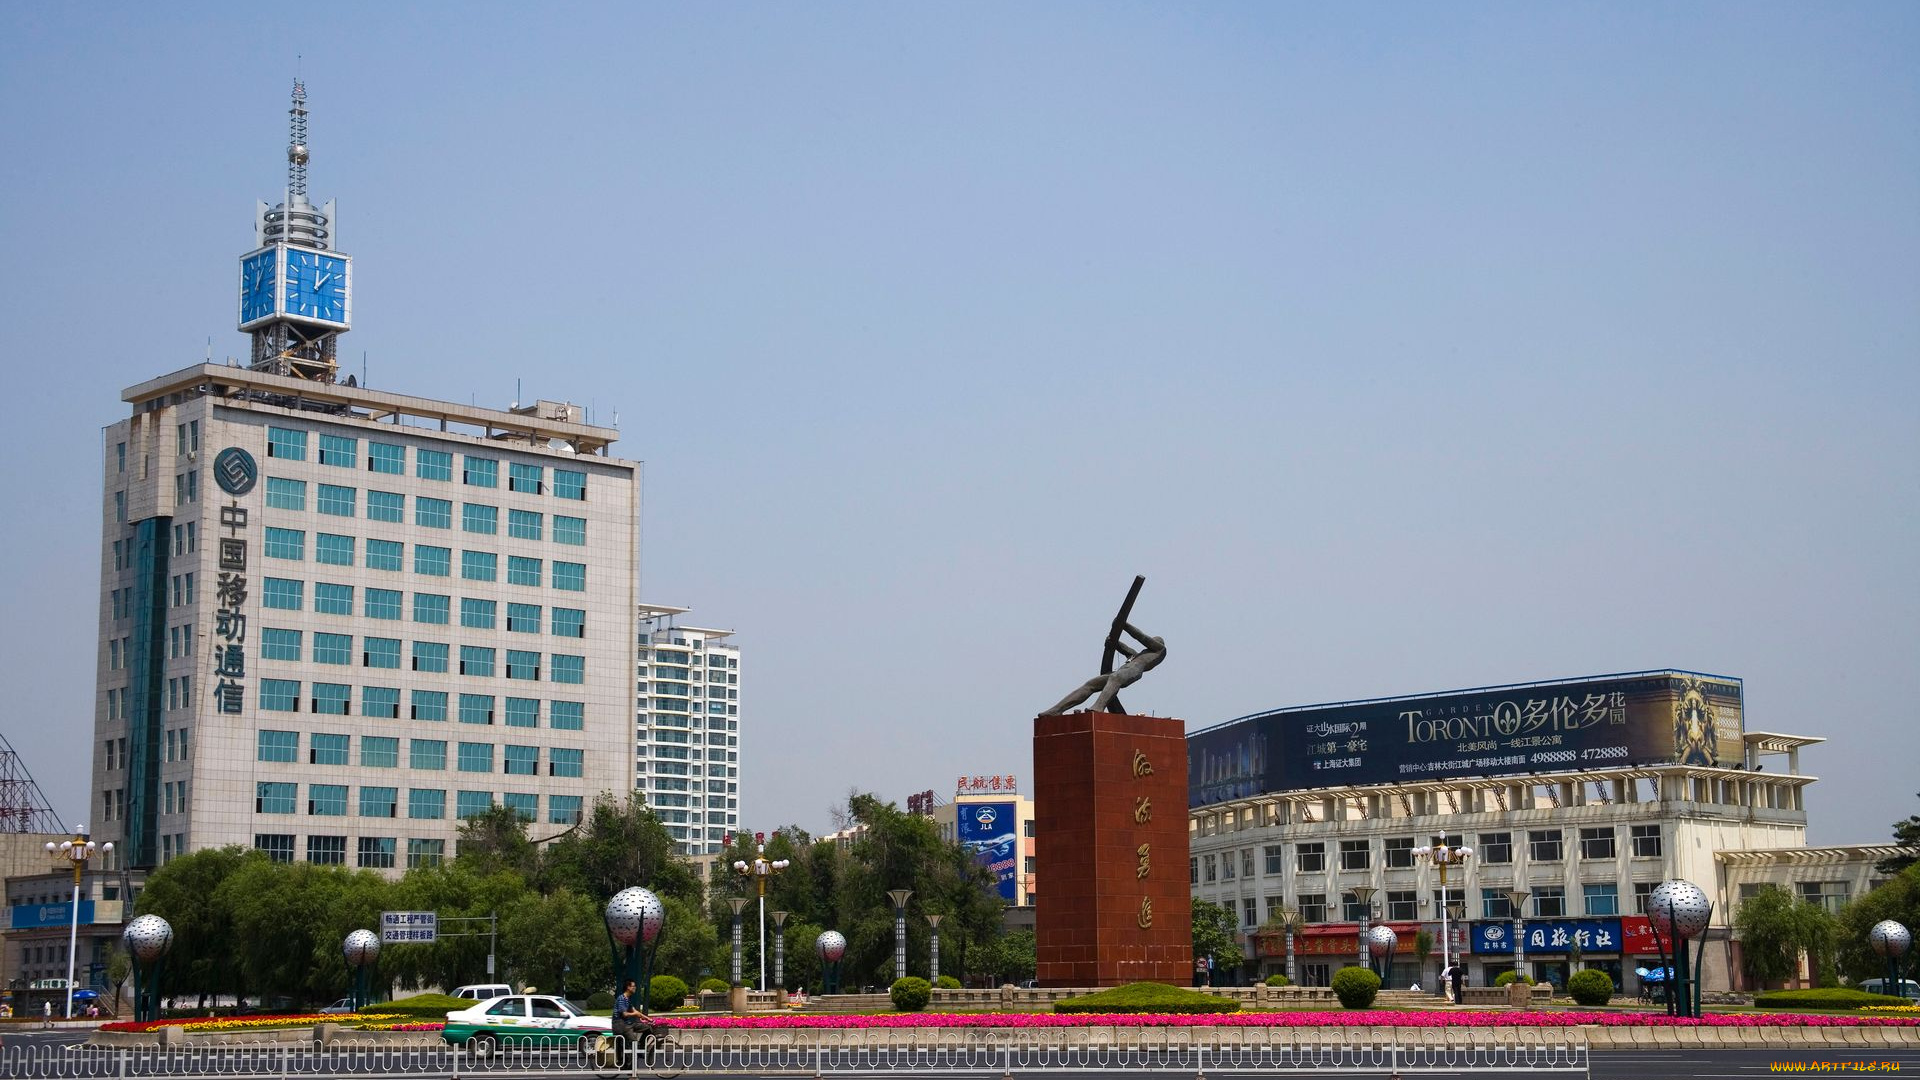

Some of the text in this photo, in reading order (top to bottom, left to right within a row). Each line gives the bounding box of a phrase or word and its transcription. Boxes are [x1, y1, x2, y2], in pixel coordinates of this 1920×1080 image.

[214, 501, 248, 714] 中国移动通信
[1426, 703, 1494, 716] GARDEN
[1398, 701, 1522, 743] TORONTO
[1457, 741, 1498, 753] 北美风尚
[1530, 749, 1577, 764] 4988888
[1581, 746, 1628, 760] 4728888
[957, 775, 1016, 791] 民航售票
[980, 823, 993, 831] JLA
[1483, 941, 1508, 949] 吉林市
